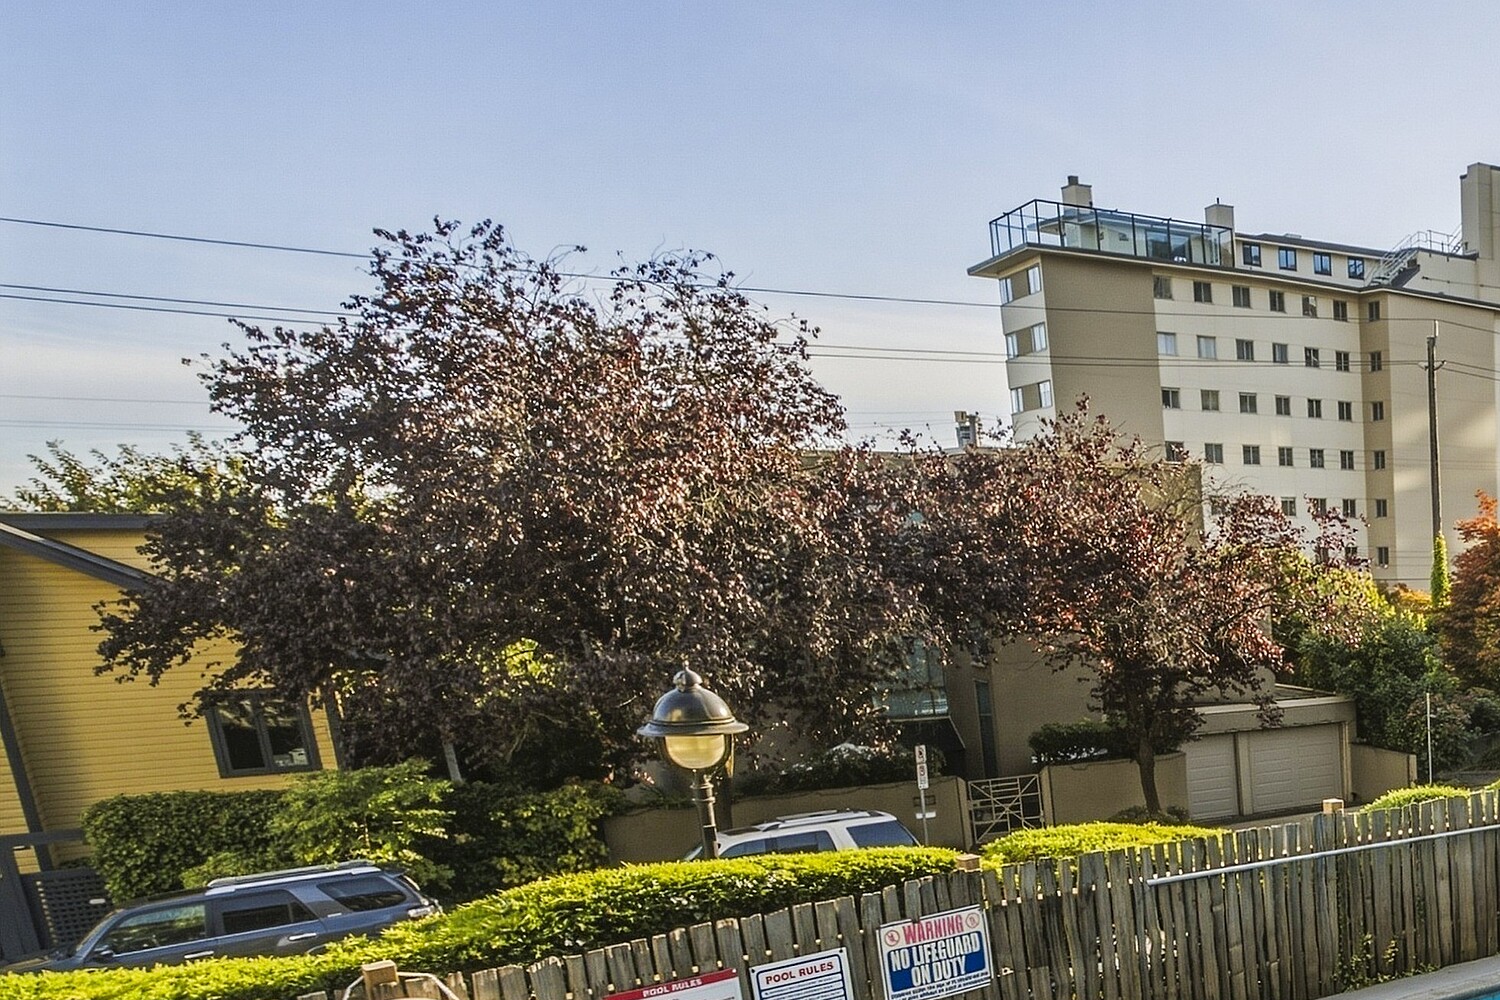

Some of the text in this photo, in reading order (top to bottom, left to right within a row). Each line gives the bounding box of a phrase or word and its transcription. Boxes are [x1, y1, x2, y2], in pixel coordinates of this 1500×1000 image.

[902, 914, 964, 945] WARNING
[890, 932, 981, 972] NO LIFEGUARD
[765, 961, 834, 985] POOL RULES
[910, 964, 931, 987] ON
[931, 955, 967, 982] DUTY
[642, 978, 703, 998] POOL RULES
